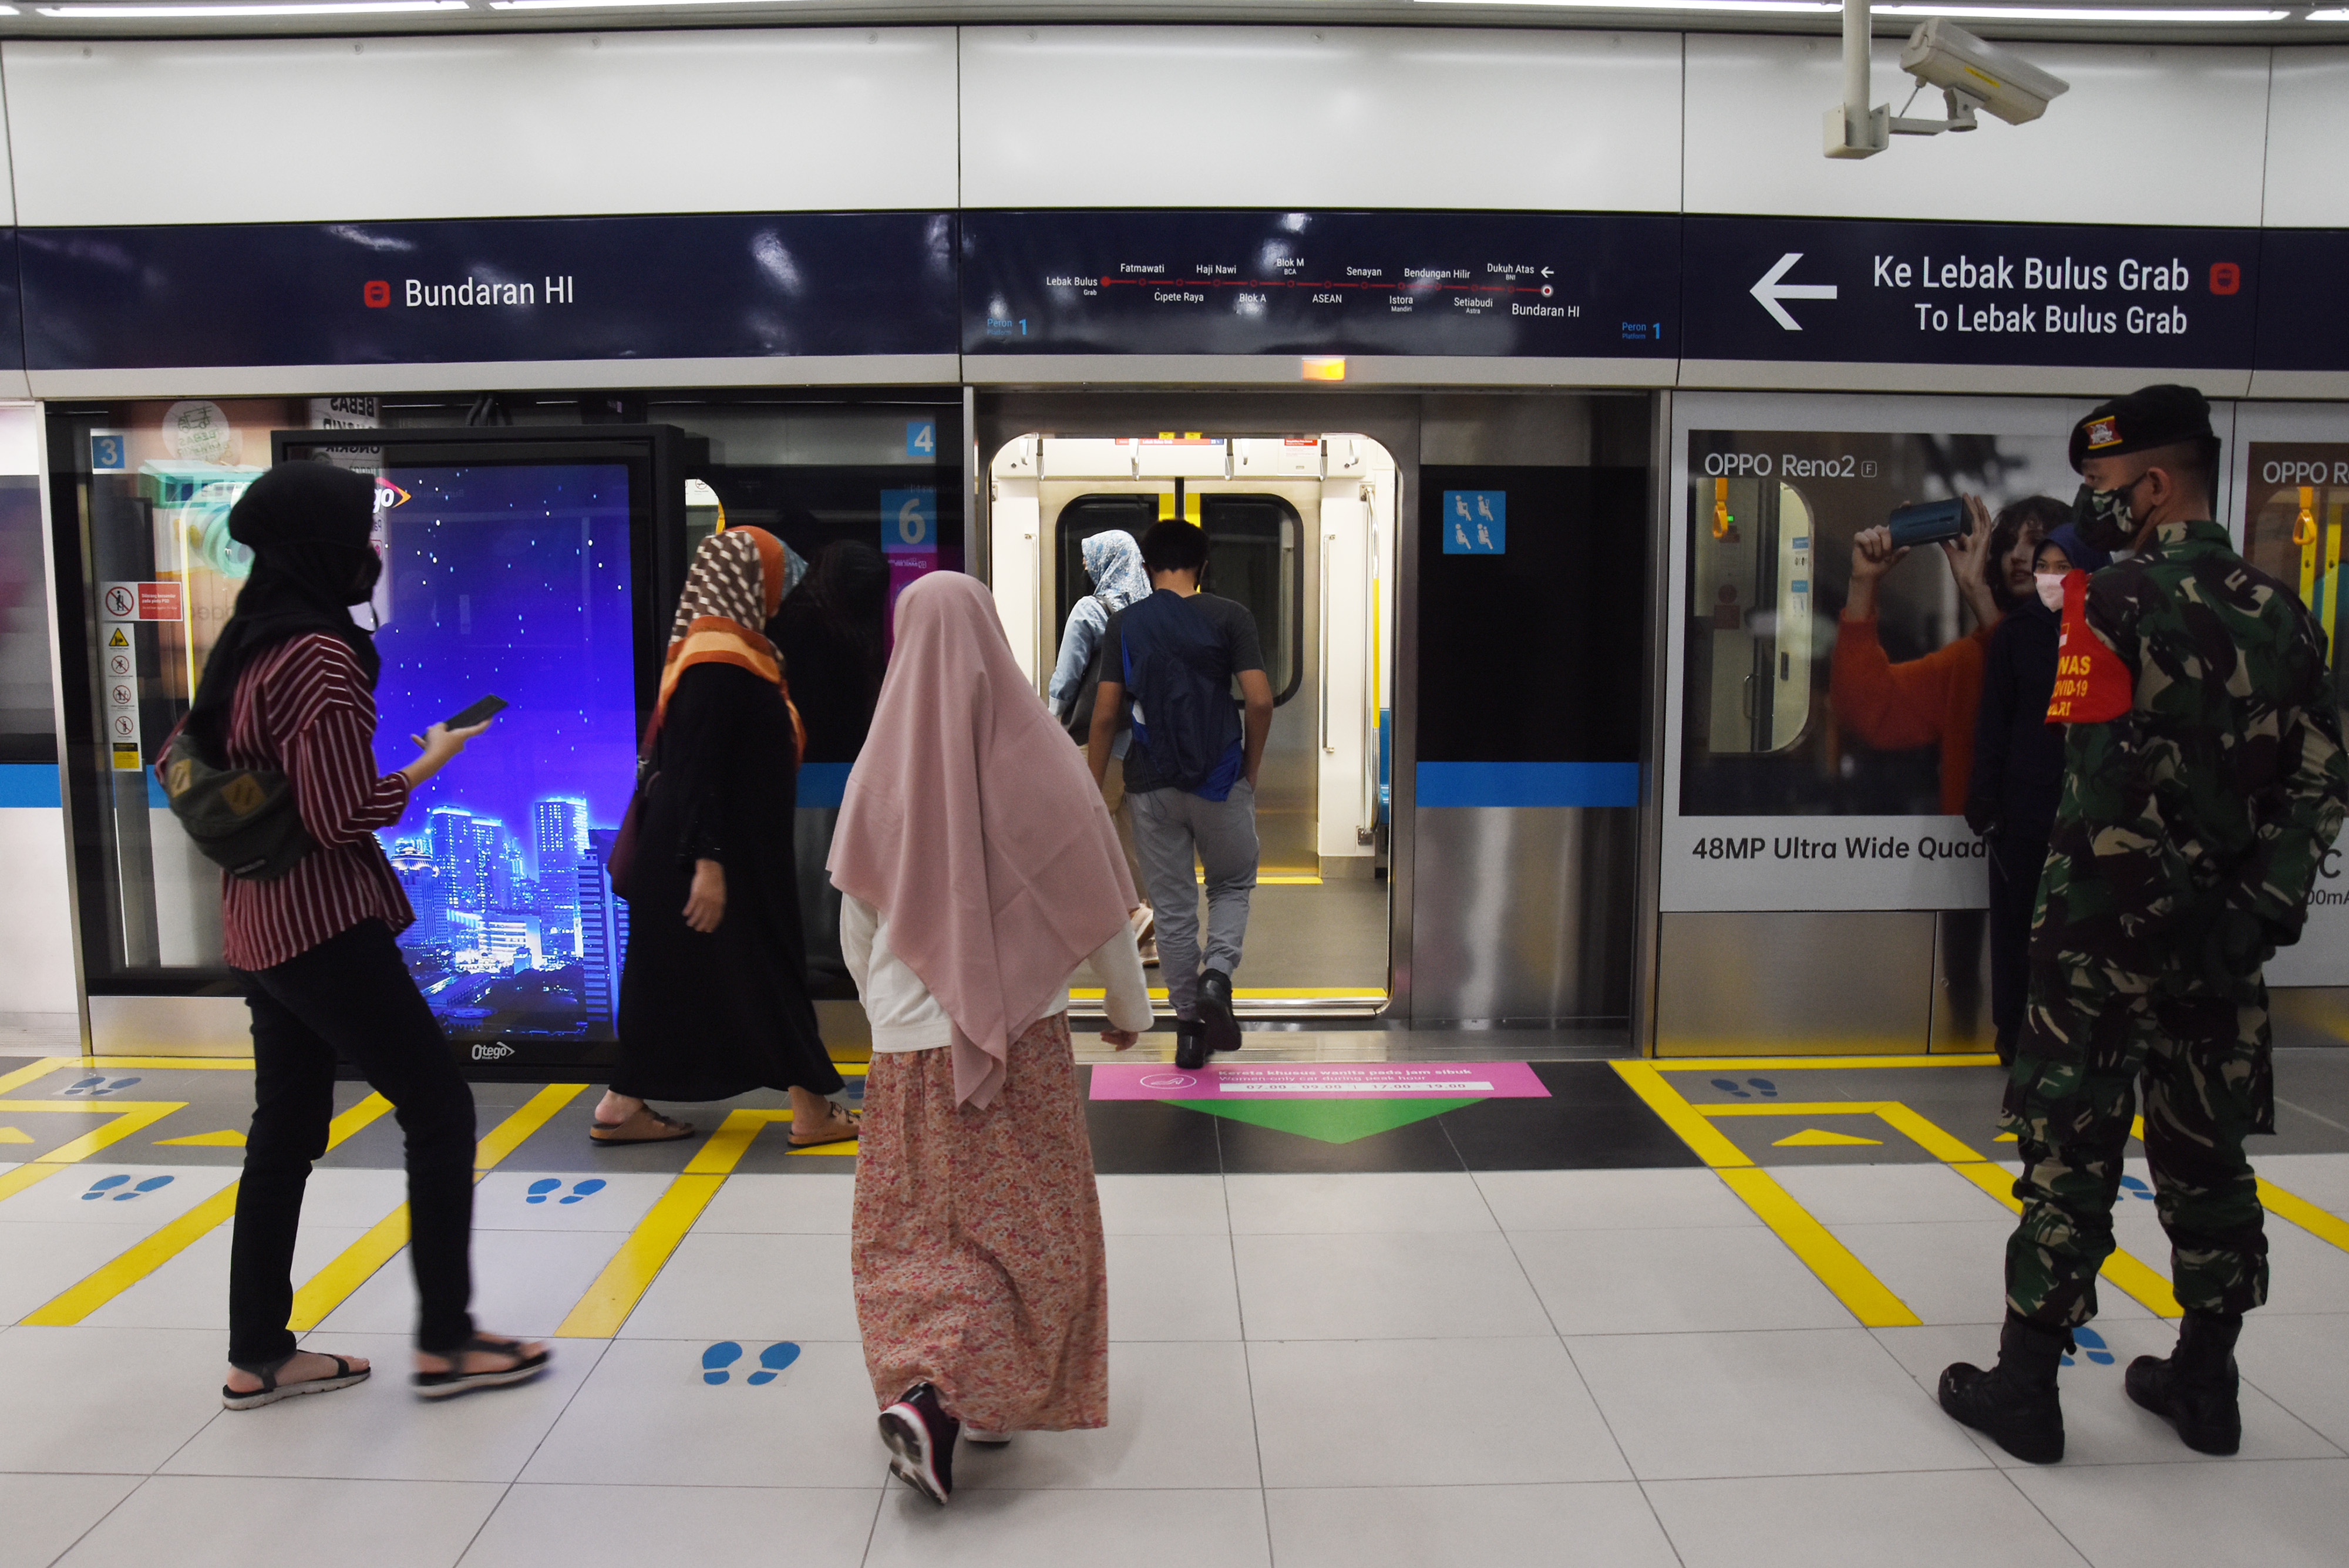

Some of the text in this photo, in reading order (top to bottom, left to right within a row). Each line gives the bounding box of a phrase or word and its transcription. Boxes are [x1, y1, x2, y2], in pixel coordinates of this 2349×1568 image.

[1120, 263, 1165, 274] Fatmawati
[1196, 264, 1237, 275] Haji Nawi
[1277, 257, 1304, 268] Blok M
[1487, 263, 1535, 275] Dukuh Atas
[1347, 266, 1382, 278] Senayan
[1404, 268, 1470, 280] Bendungan Hilir
[1873, 254, 2190, 292] Ke Lebak Bulus Grab
[1046, 275, 1098, 287] Lebak Bulus
[405, 275, 574, 308] Bundaran HI
[1154, 289, 1204, 303] Cipete Raya
[1239, 293, 1267, 303] Blok A
[1312, 294, 1342, 304] ASEAN
[1389, 295, 1414, 305] Istora
[1454, 297, 1493, 308] Setiabudi
[1512, 303, 1580, 318] Bundaran HI
[1914, 302, 2188, 335] To Lebak Bulus Grab
[987, 318, 1028, 335] Peron 1
[1622, 321, 1661, 340] Peron 1
[914, 425, 933, 452] 4
[100, 438, 118, 466] 3
[1704, 453, 1772, 477] OPPO
[1781, 454, 1856, 479] Reno2
[2263, 460, 2327, 484] OPPO
[898, 498, 926, 545] 6
[1692, 836, 1987, 861] 48MP Ultra Wide Quad
[471, 1044, 507, 1061] Otego
